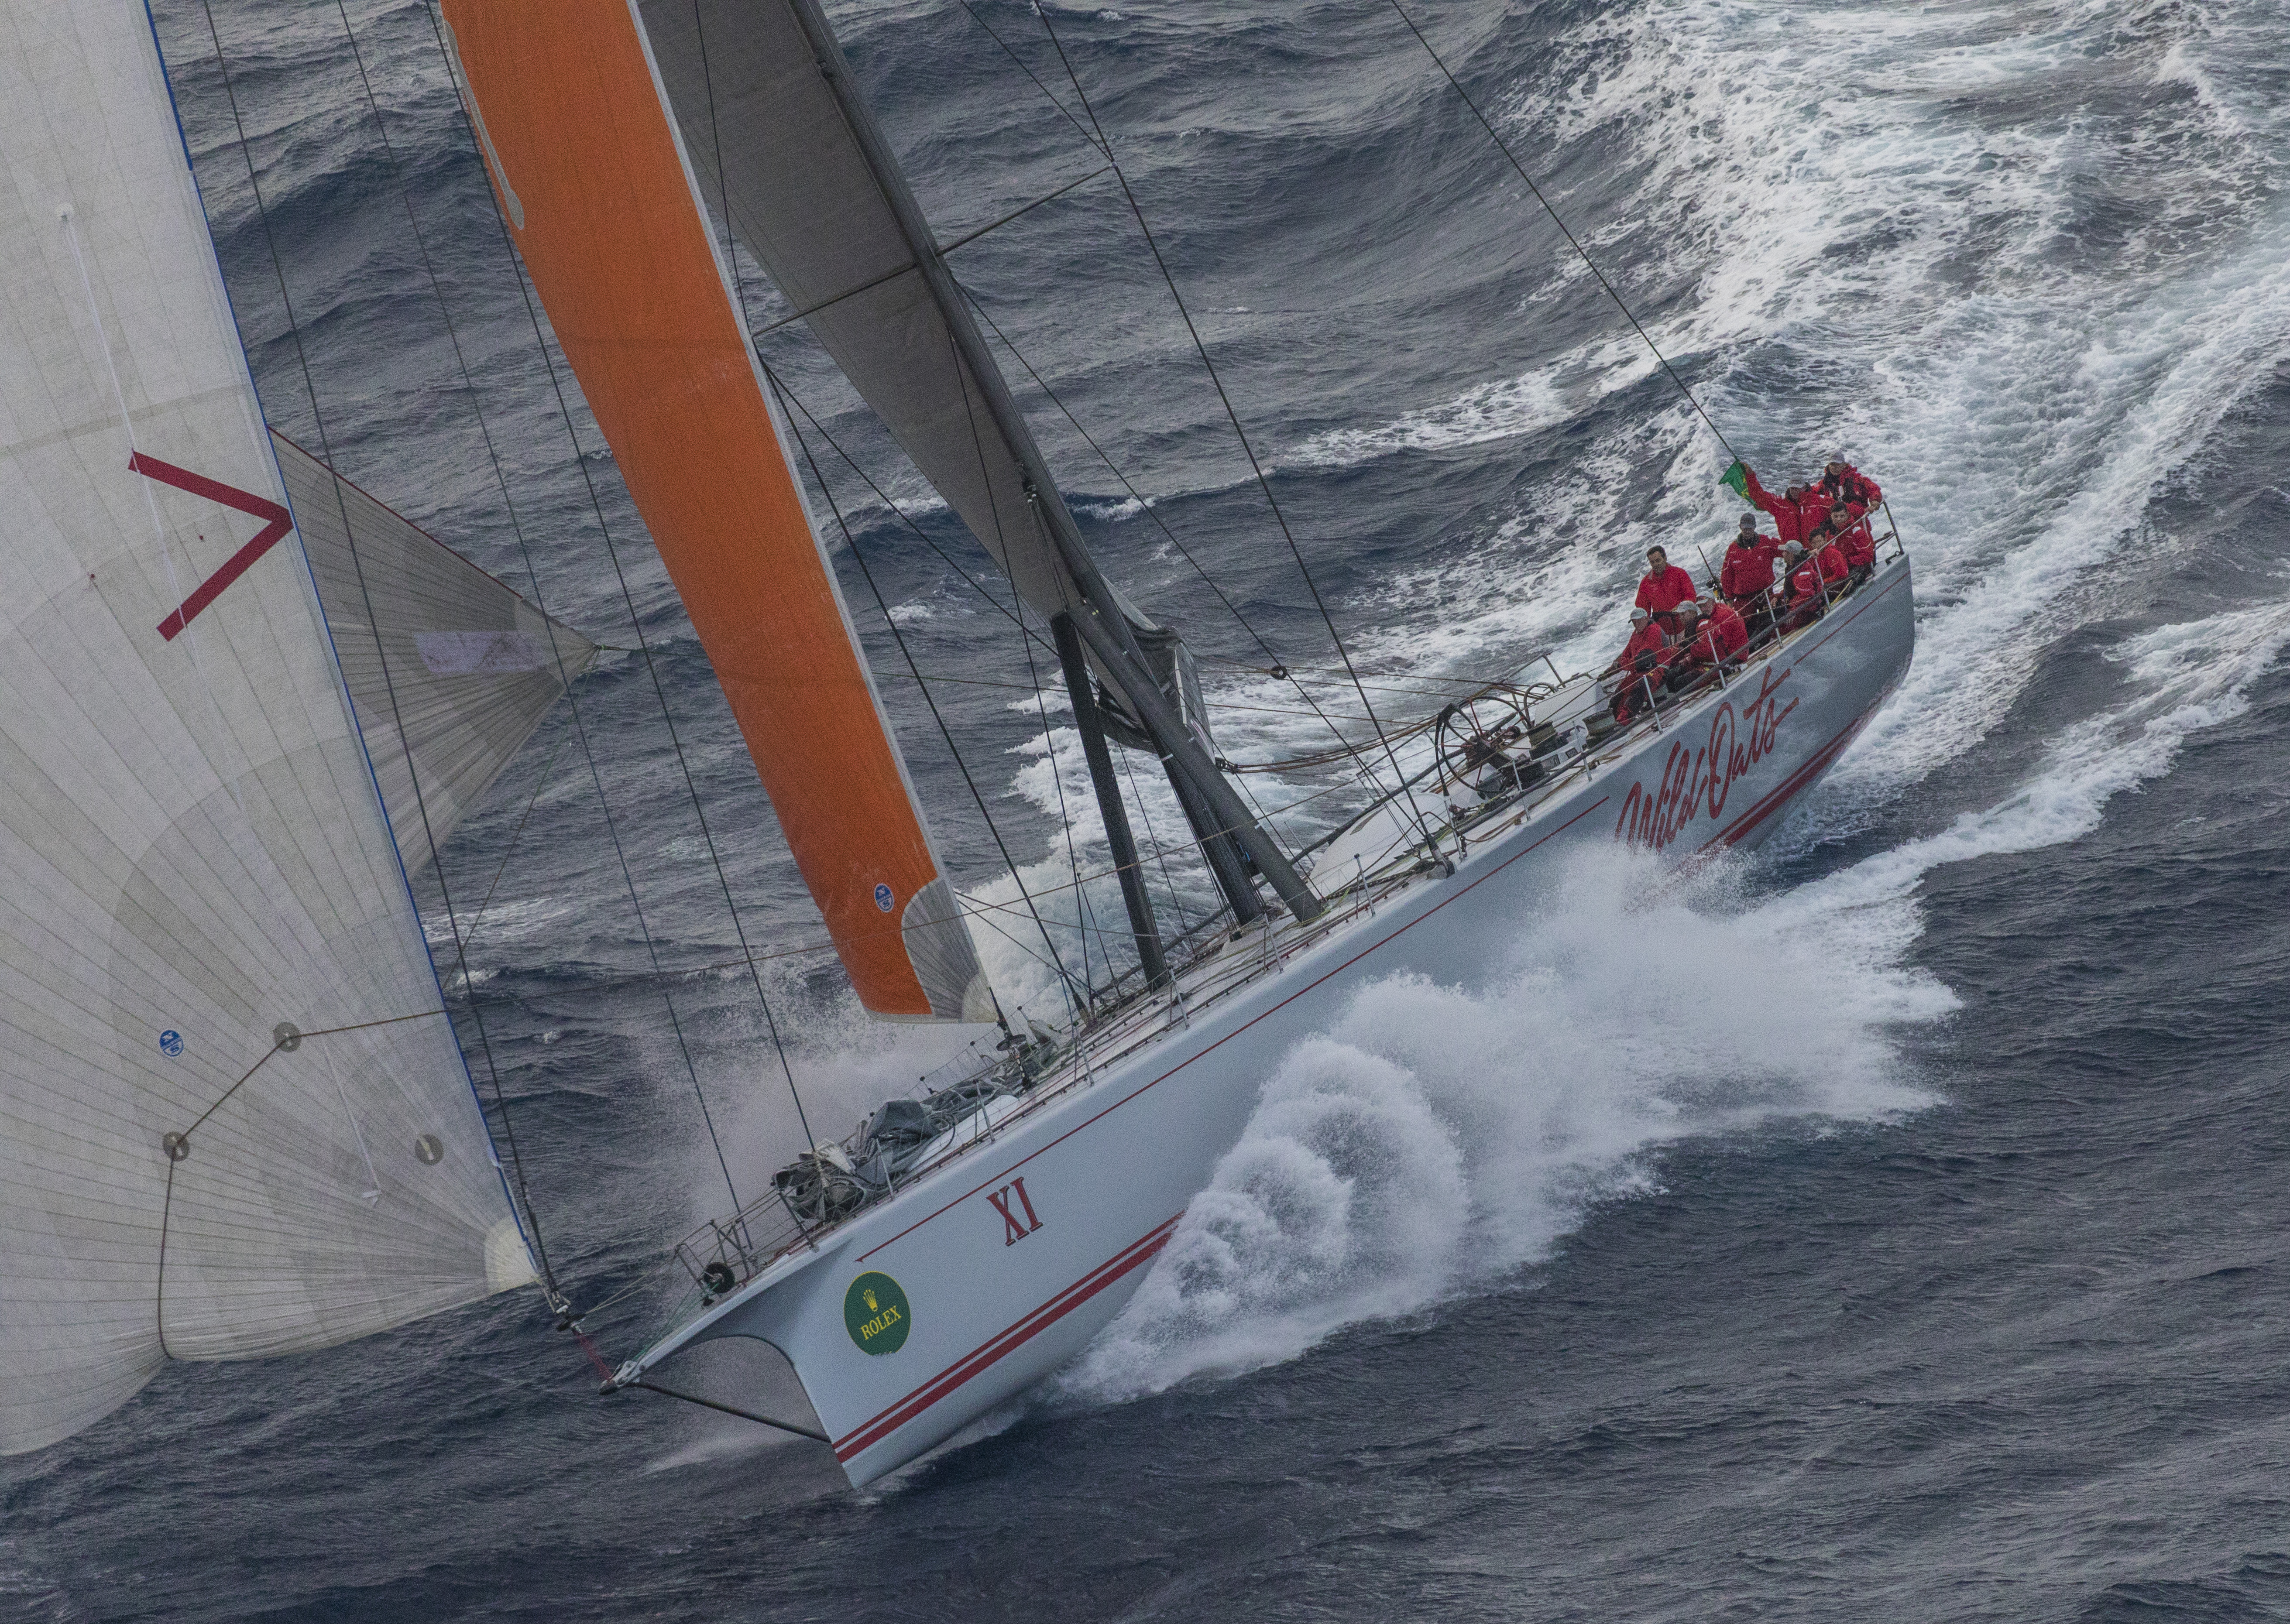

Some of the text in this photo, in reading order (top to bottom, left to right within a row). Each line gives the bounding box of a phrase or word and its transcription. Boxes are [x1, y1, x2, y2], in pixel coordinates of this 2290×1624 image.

[1708, 665, 1799, 819] Oats
[986, 1176, 1044, 1247] XI
[860, 1305, 902, 1340] ROLEX
